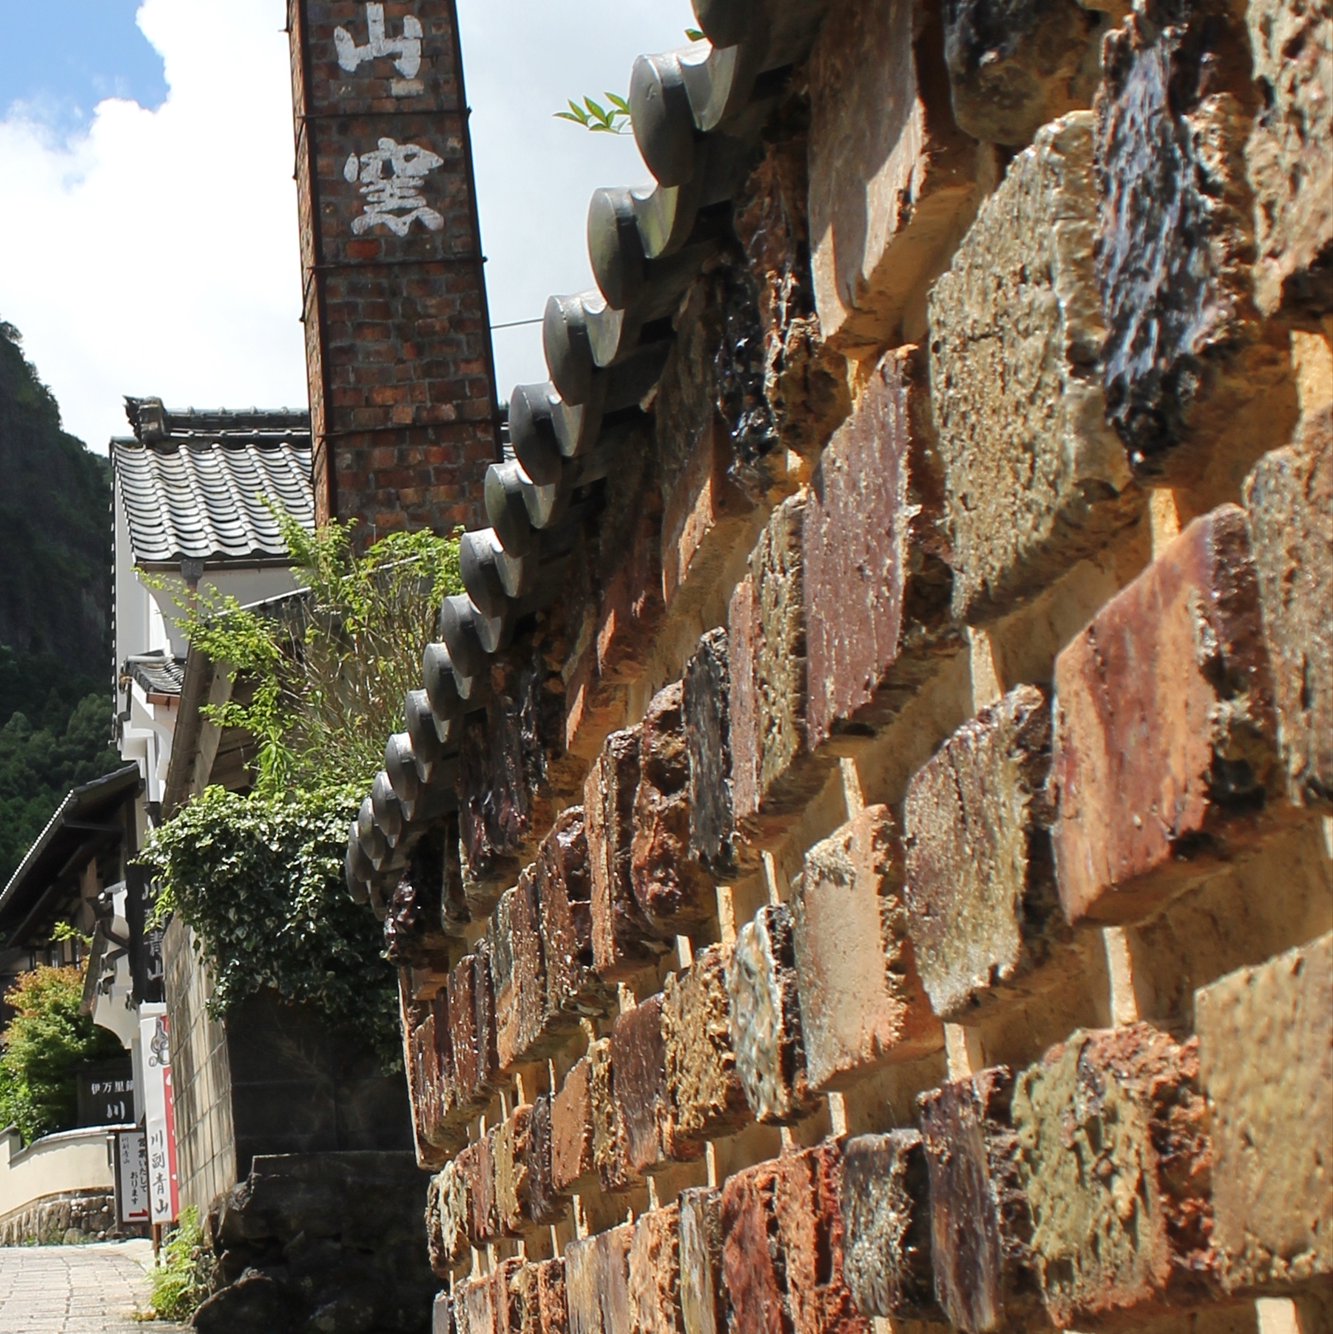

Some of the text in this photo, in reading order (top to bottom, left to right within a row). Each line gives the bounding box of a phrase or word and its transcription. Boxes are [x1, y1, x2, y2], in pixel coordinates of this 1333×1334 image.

[130, 1171, 139, 1206] おります
[151, 1130, 169, 1215] 川副青山
